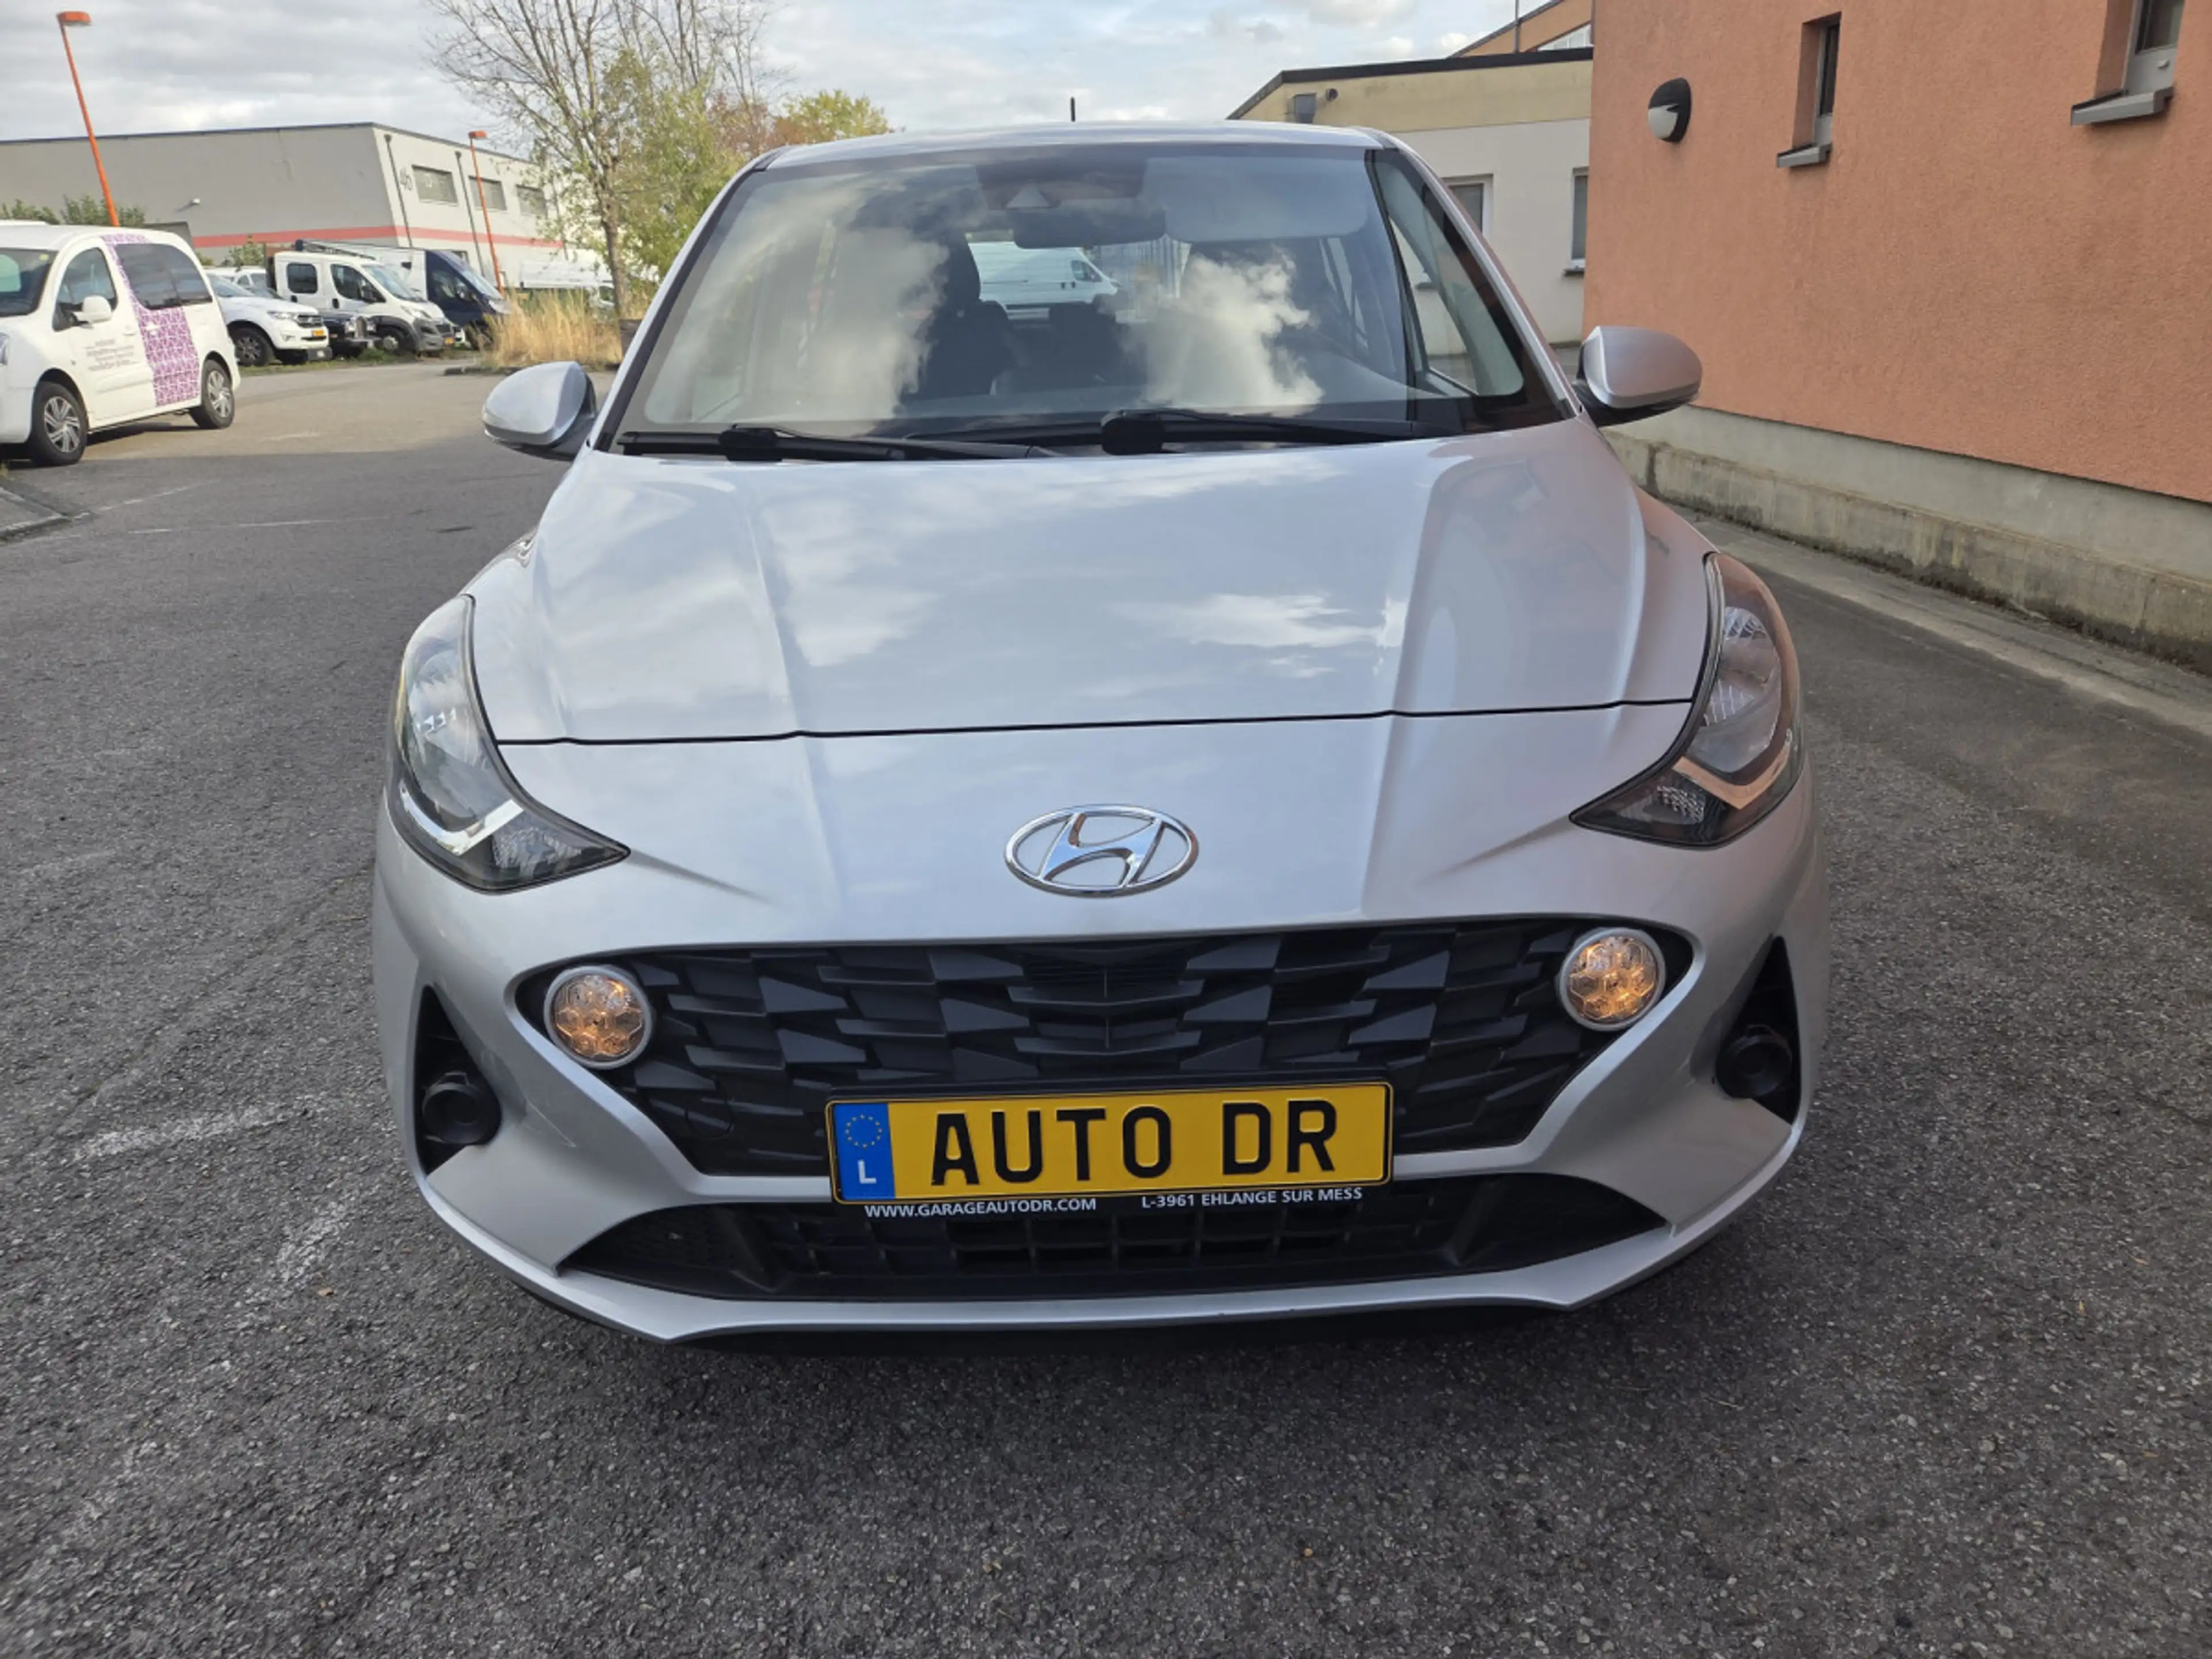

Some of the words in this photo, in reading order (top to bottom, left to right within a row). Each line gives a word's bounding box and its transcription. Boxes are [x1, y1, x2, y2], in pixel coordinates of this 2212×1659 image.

[931, 1105, 1172, 1186] AUTO
[1221, 1099, 1338, 1176] DR
[857, 1159, 877, 1184] L
[864, 1199, 1096, 1218] WWW.GARAGEAUTODR.COM
[1142, 1194, 1195, 1209] L-3961
[1202, 1191, 1277, 1206] EHLANGE
[1282, 1189, 1313, 1203] SUR
[1318, 1187, 1363, 1201] MESS
